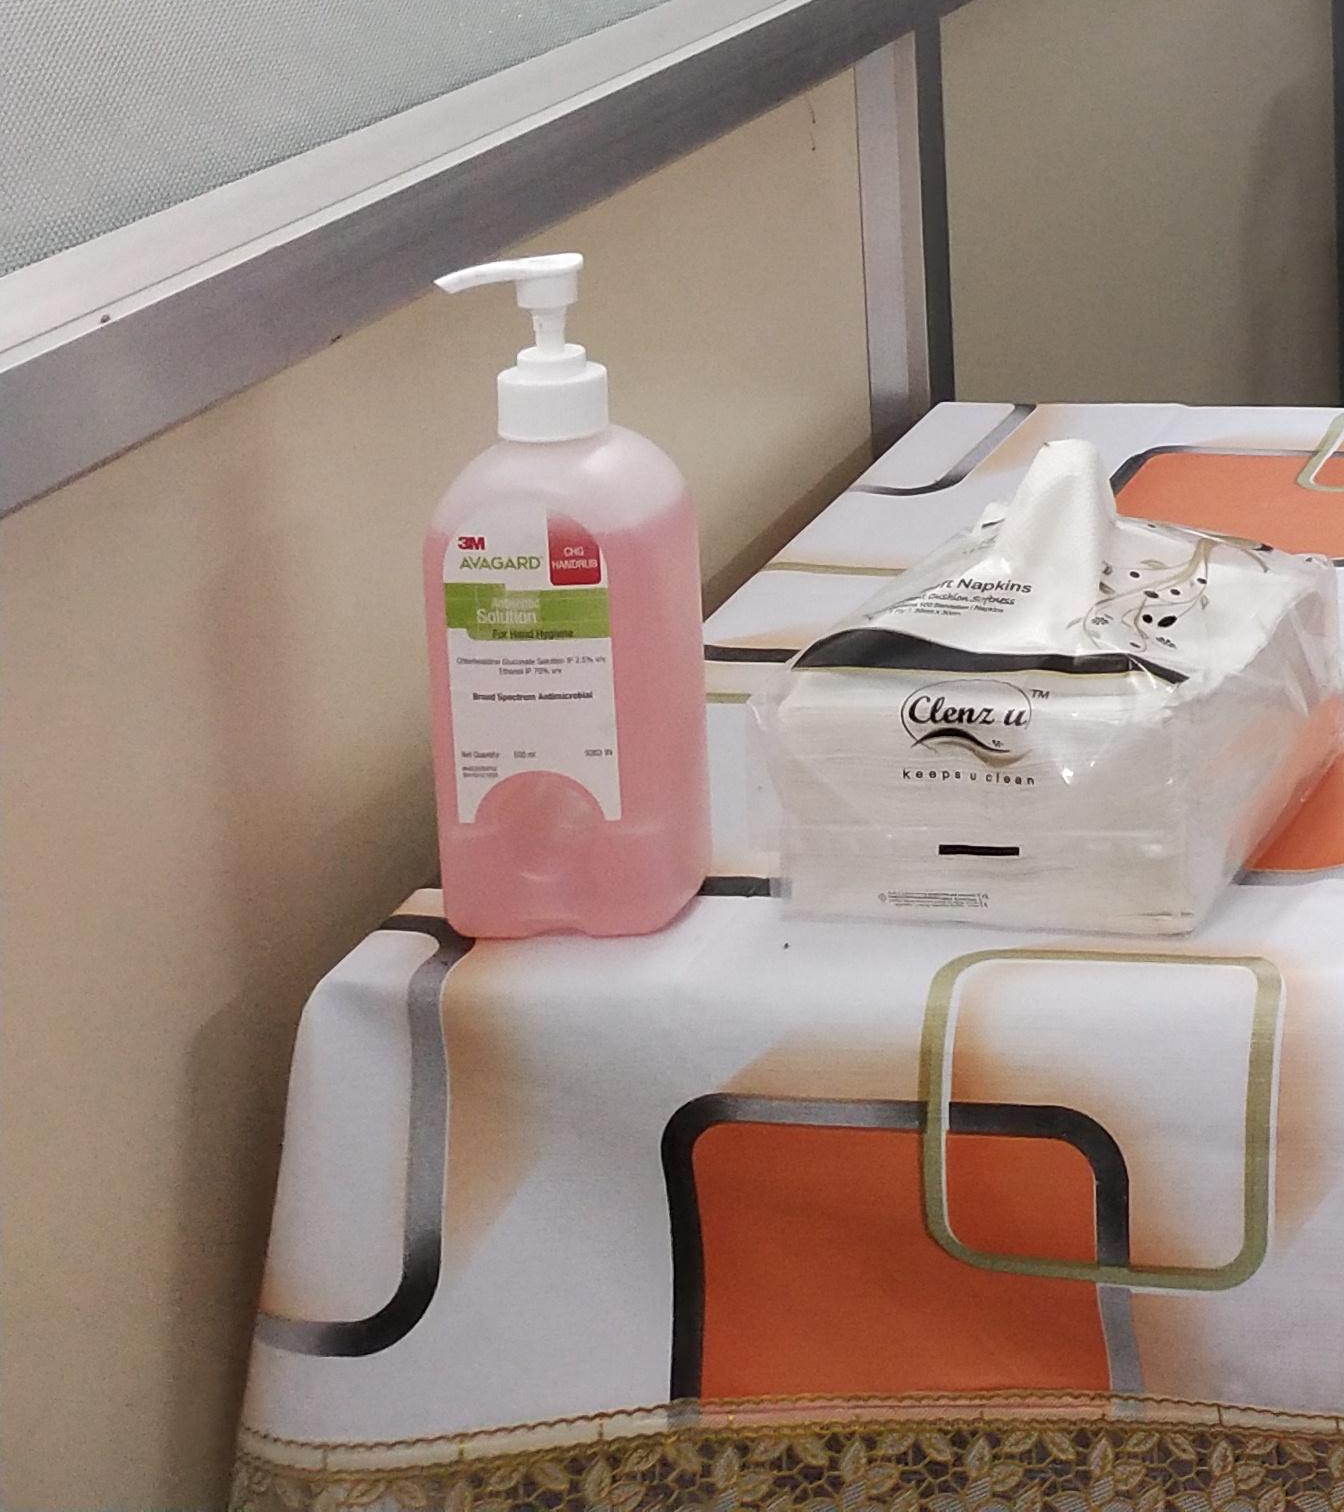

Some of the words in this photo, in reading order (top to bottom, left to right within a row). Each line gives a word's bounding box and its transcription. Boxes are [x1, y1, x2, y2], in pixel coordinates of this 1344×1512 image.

[458, 536, 486, 550] 3M
[459, 556, 541, 570] AVAGARD
[551, 559, 598, 569] HANDRUB
[957, 578, 1033, 593] Napkins
[477, 609, 537, 624] Solution
[509, 630, 534, 639] Hand
[535, 630, 574, 641] Hygiene
[472, 692, 496, 700] Broad
[497, 692, 536, 702] Spectrum
[538, 690, 593, 700] Antimicrobial
[908, 695, 996, 725] Clenz
[1003, 708, 1028, 727] u
[902, 769, 961, 781] keeps
[969, 772, 977, 781] u
[985, 772, 1035, 785] clean
